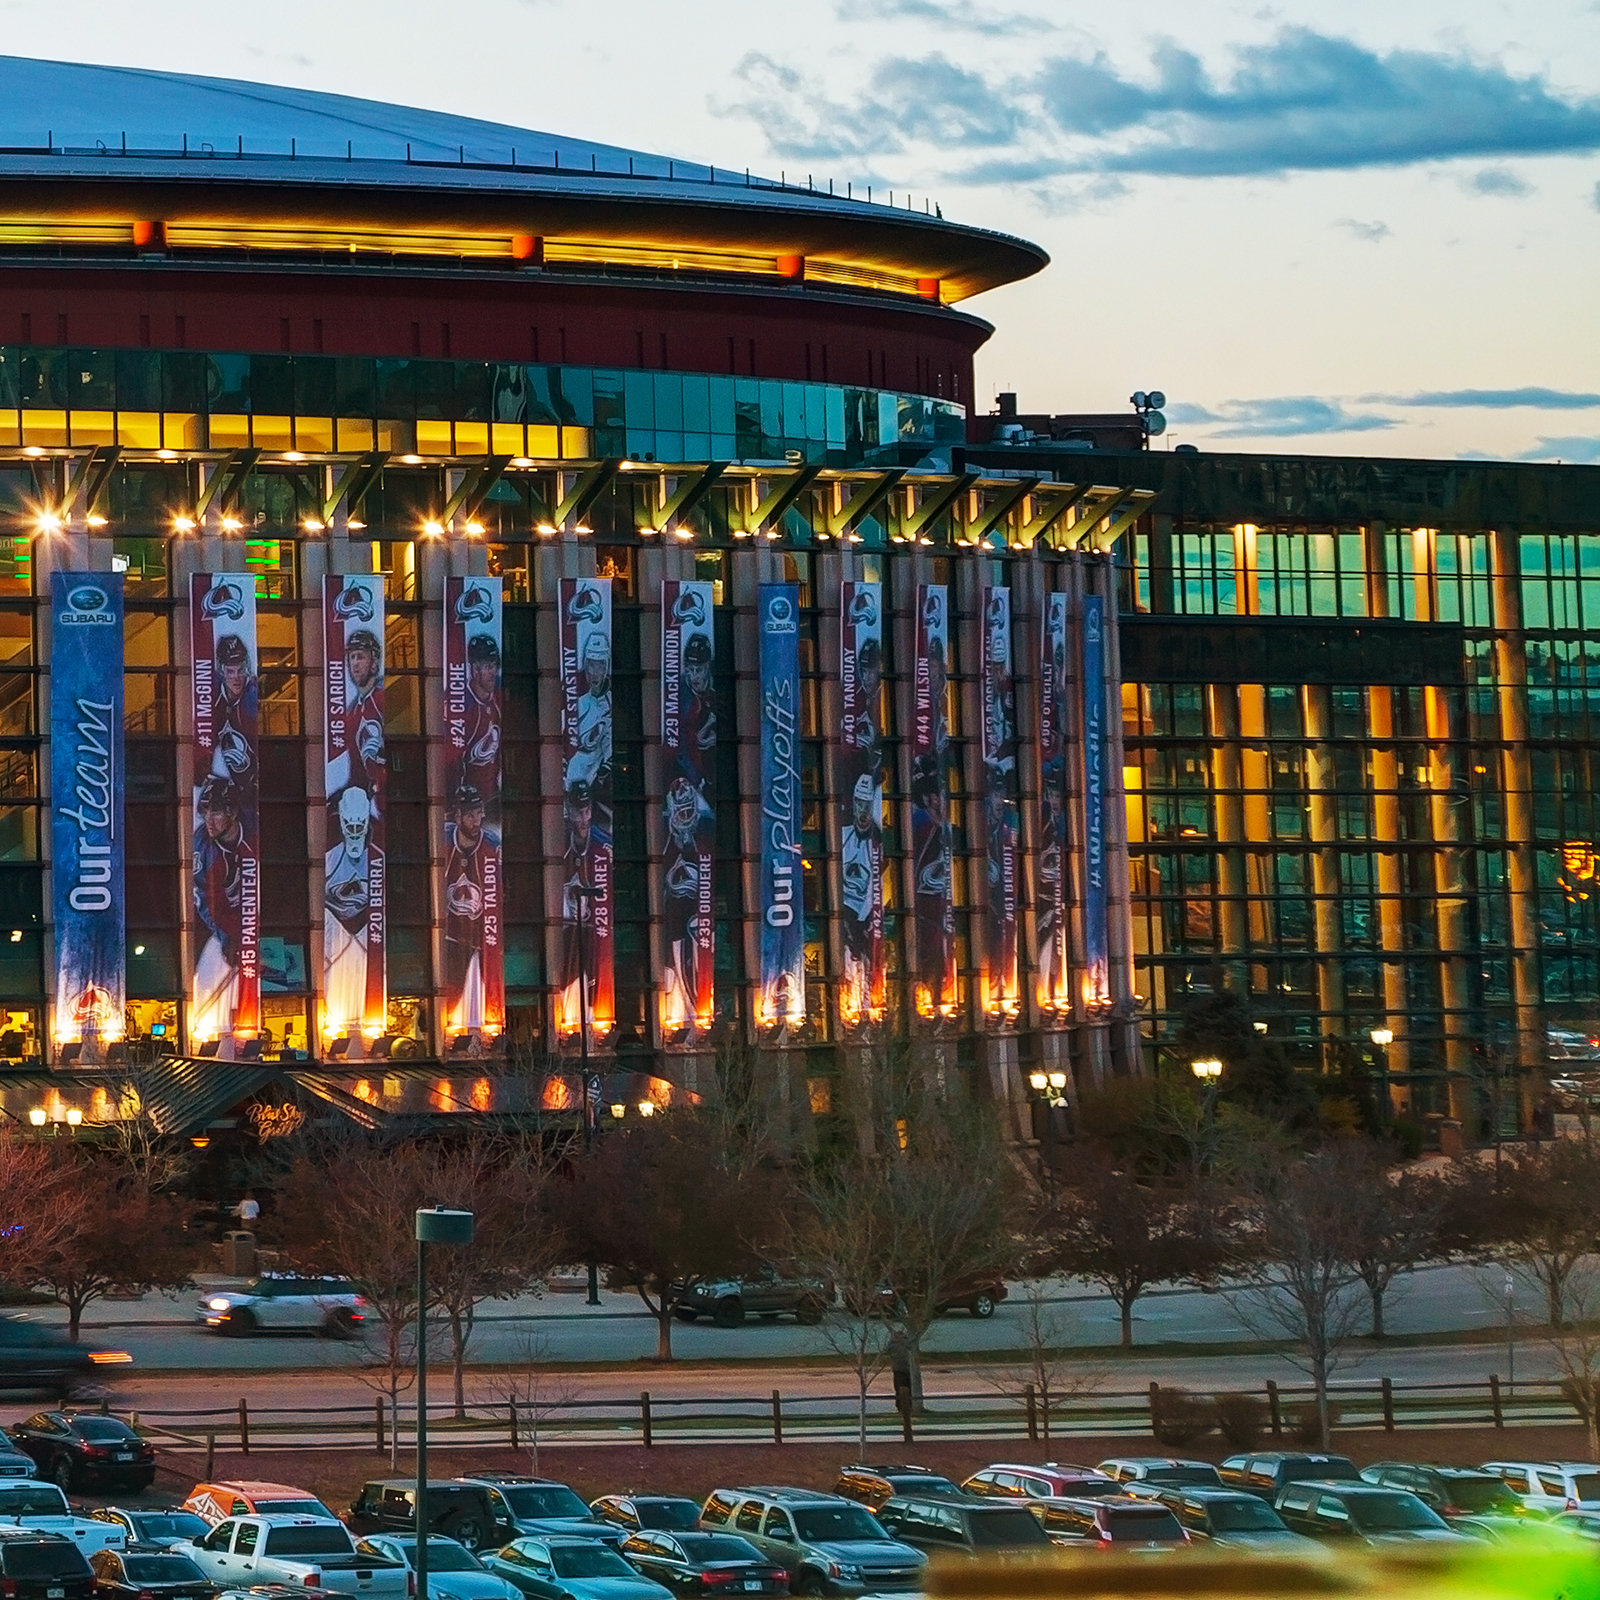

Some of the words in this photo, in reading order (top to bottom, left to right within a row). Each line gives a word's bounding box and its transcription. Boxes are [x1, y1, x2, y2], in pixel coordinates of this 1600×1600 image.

[61, 614, 114, 623] SUBARU
[329, 660, 345, 714] SARICH
[450, 662, 465, 714] CLICHE
[564, 646, 578, 712] STASTNY
[917, 657, 929, 710] WILSON
[198, 720, 212, 747] #11
[330, 718, 345, 748] #16
[451, 718, 465, 748] #24
[567, 716, 578, 747] #26
[666, 716, 679, 748] #29
[917, 714, 930, 745] #44
[59, 697, 113, 831] team
[762, 676, 801, 855] playoffs
[69, 837, 112, 911] Our
[369, 857, 383, 907] BERRA
[484, 856, 496, 911] TALBOT
[1003, 845, 1014, 892] BENOIT
[241, 857, 256, 945] PARENTEAU
[766, 858, 794, 927] Our
[370, 912, 383, 944] #20
[485, 914, 497, 946] #25
[595, 908, 608, 938] #28
[699, 917, 710, 949] #35
[242, 950, 256, 978] #15
